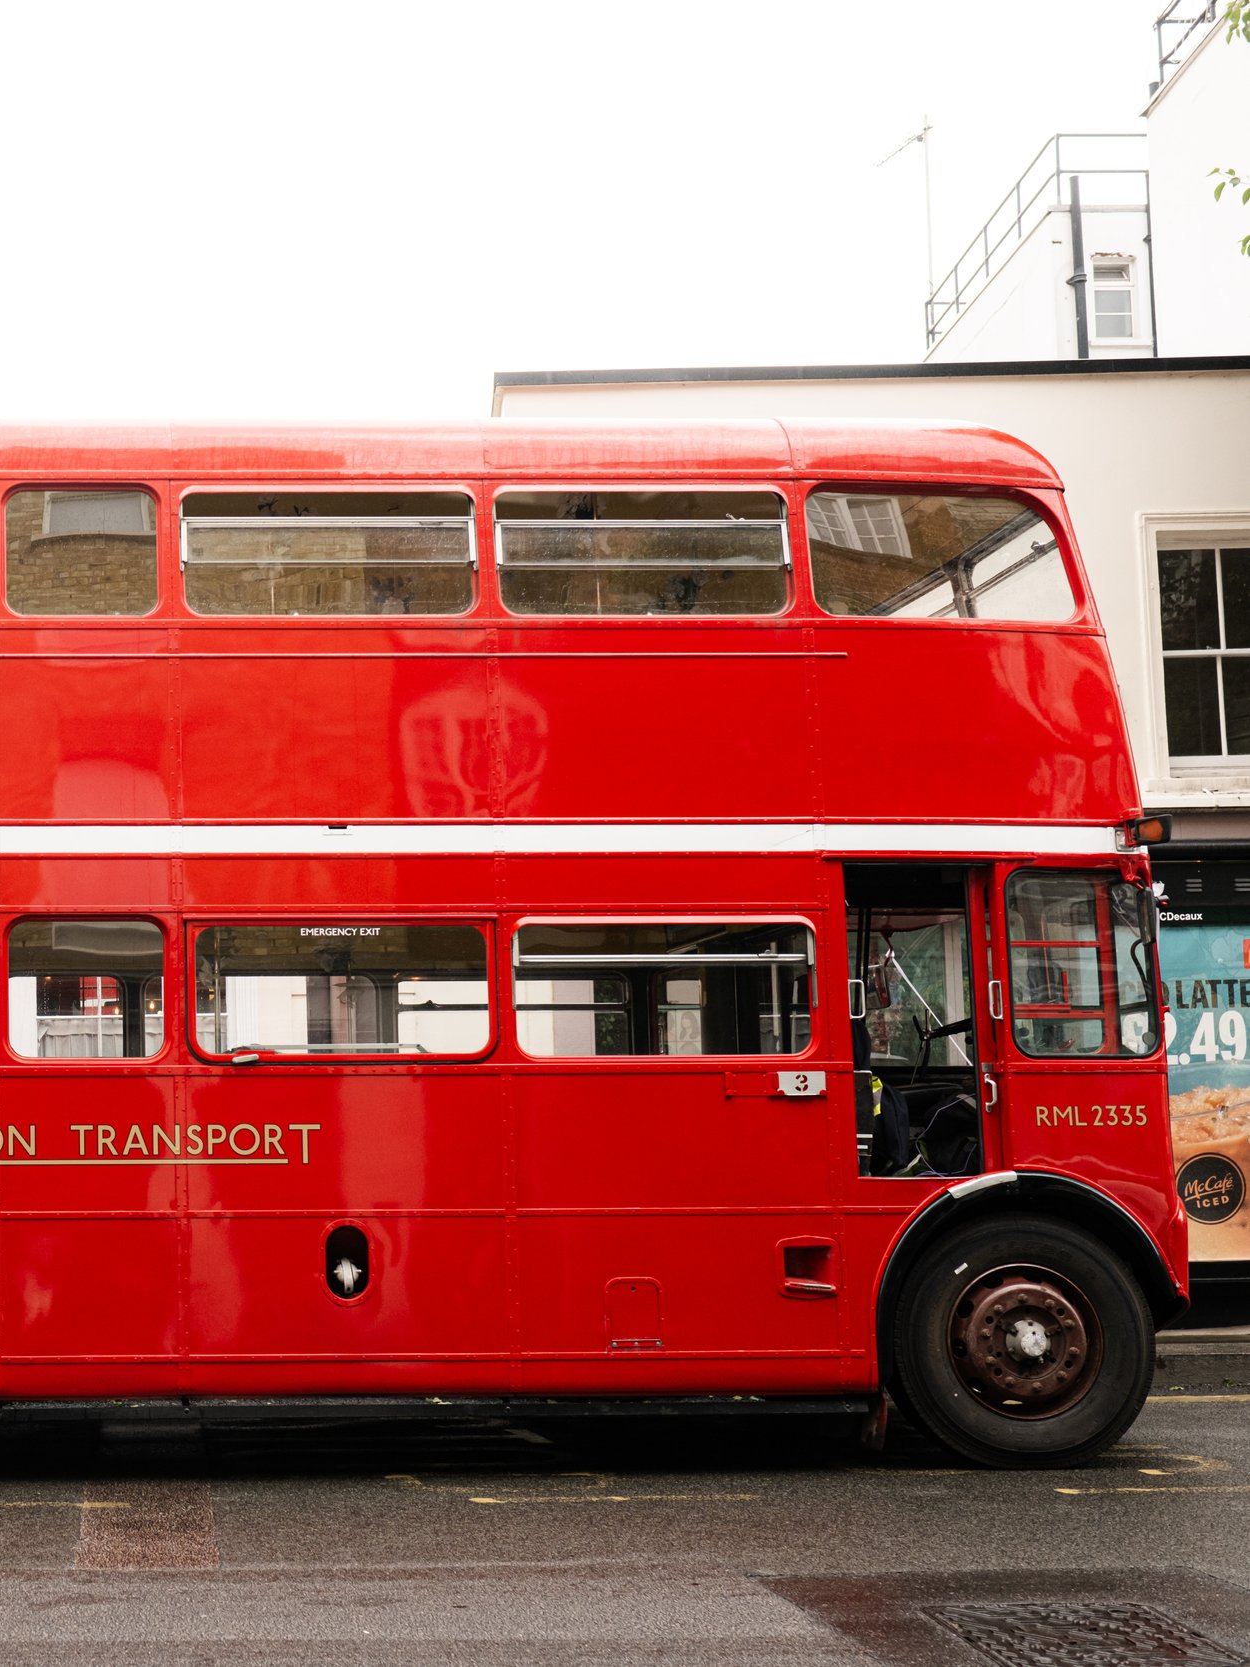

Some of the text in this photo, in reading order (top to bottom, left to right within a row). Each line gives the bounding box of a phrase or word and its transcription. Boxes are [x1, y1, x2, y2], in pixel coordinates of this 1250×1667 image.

[1158, 911, 1204, 922] CDecaux
[300, 927, 381, 936] EMERGENCY EXIT
[1175, 979, 1250, 1009] LATTE
[795, 1074, 809, 1092] 3
[1035, 1104, 1148, 1127] RML 2335
[70, 1123, 321, 1165] TRANSPORT
[1184, 1172, 1234, 1200] McCafé
[1197, 1195, 1230, 1209] ICED
